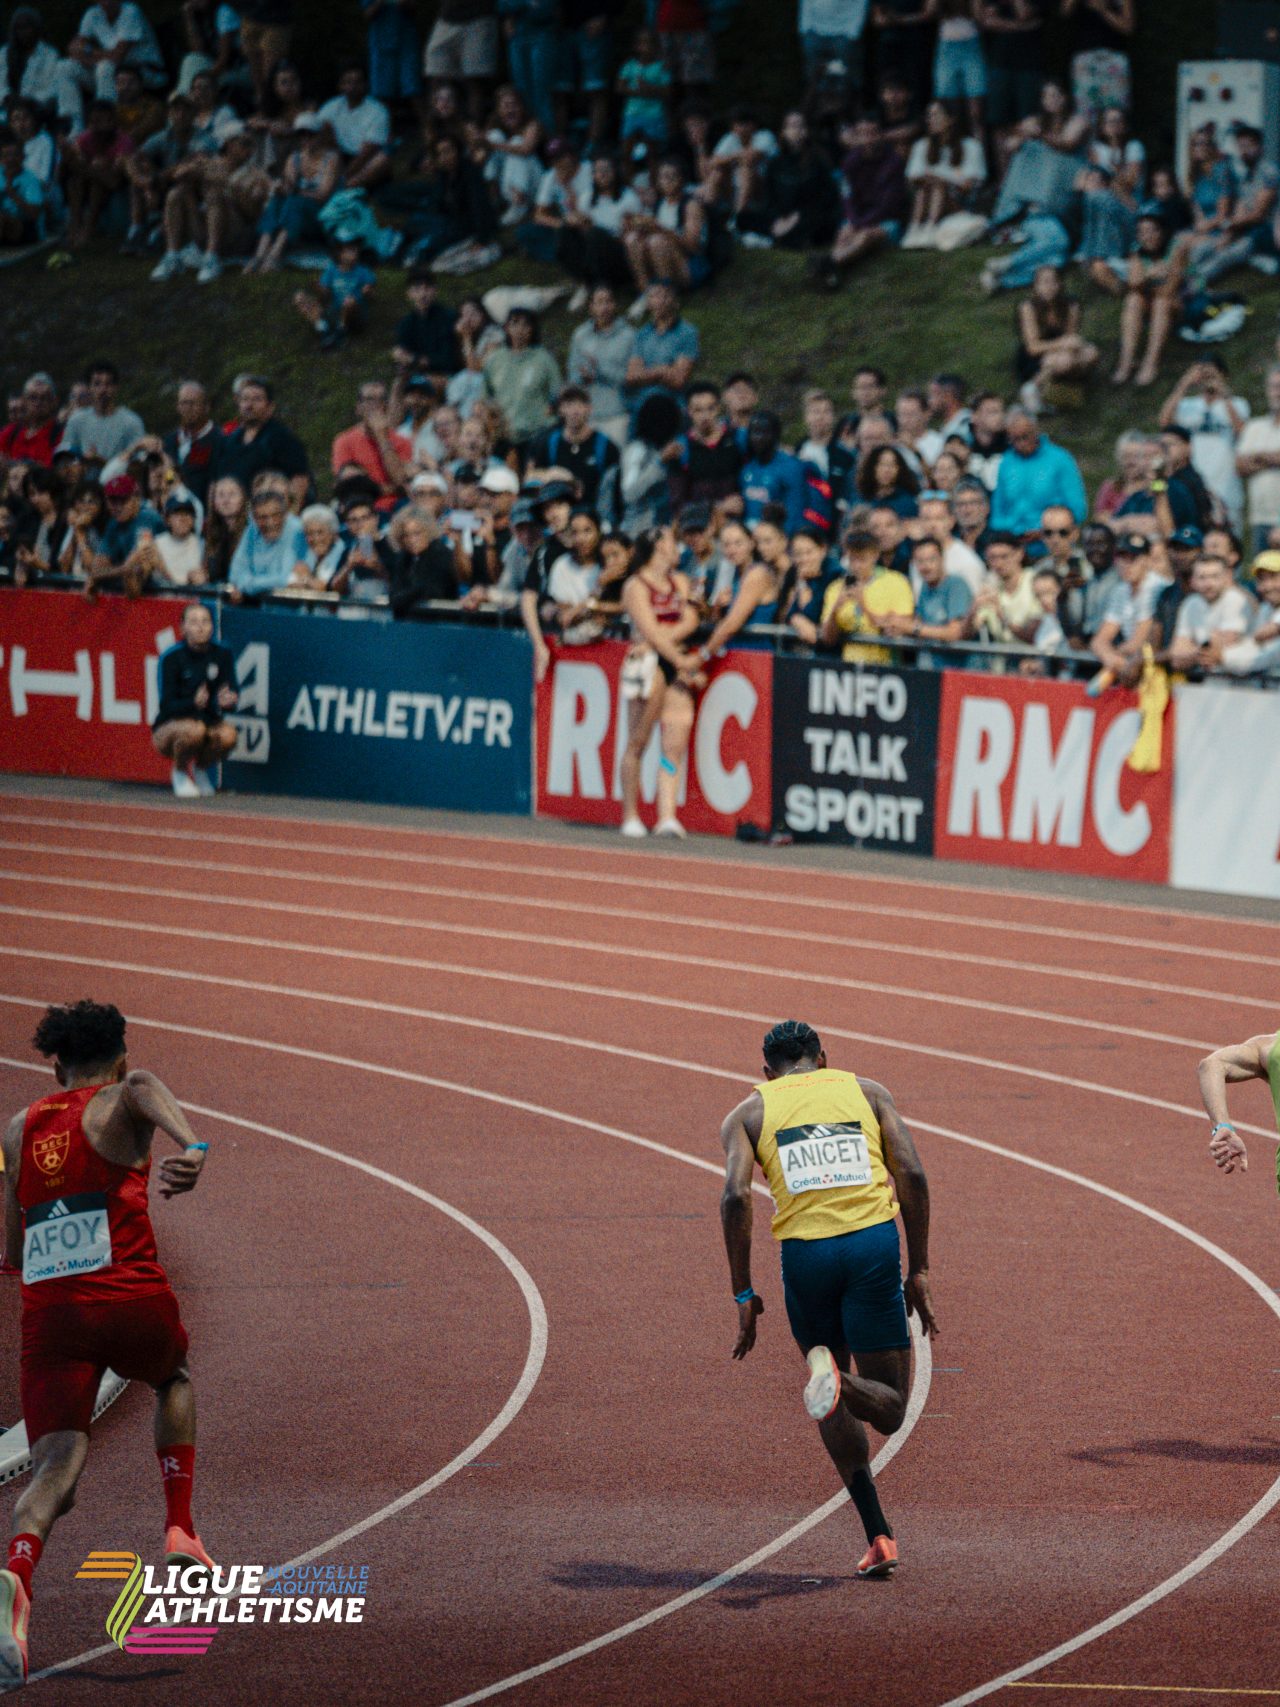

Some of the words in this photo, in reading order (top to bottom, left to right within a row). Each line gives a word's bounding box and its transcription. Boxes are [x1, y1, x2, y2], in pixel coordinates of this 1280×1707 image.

[287, 683, 513, 748] ATHLETV.FR
[809, 669, 908, 723] INFO
[804, 727, 908, 782] TALK
[947, 696, 1152, 856] RMC
[785, 784, 923, 843] SPORT
[787, 1138, 863, 1172] ANICET
[792, 1176, 821, 1190] Crédit
[834, 1172, 867, 1182] Mutuel
[28, 1217, 101, 1260] AFOY
